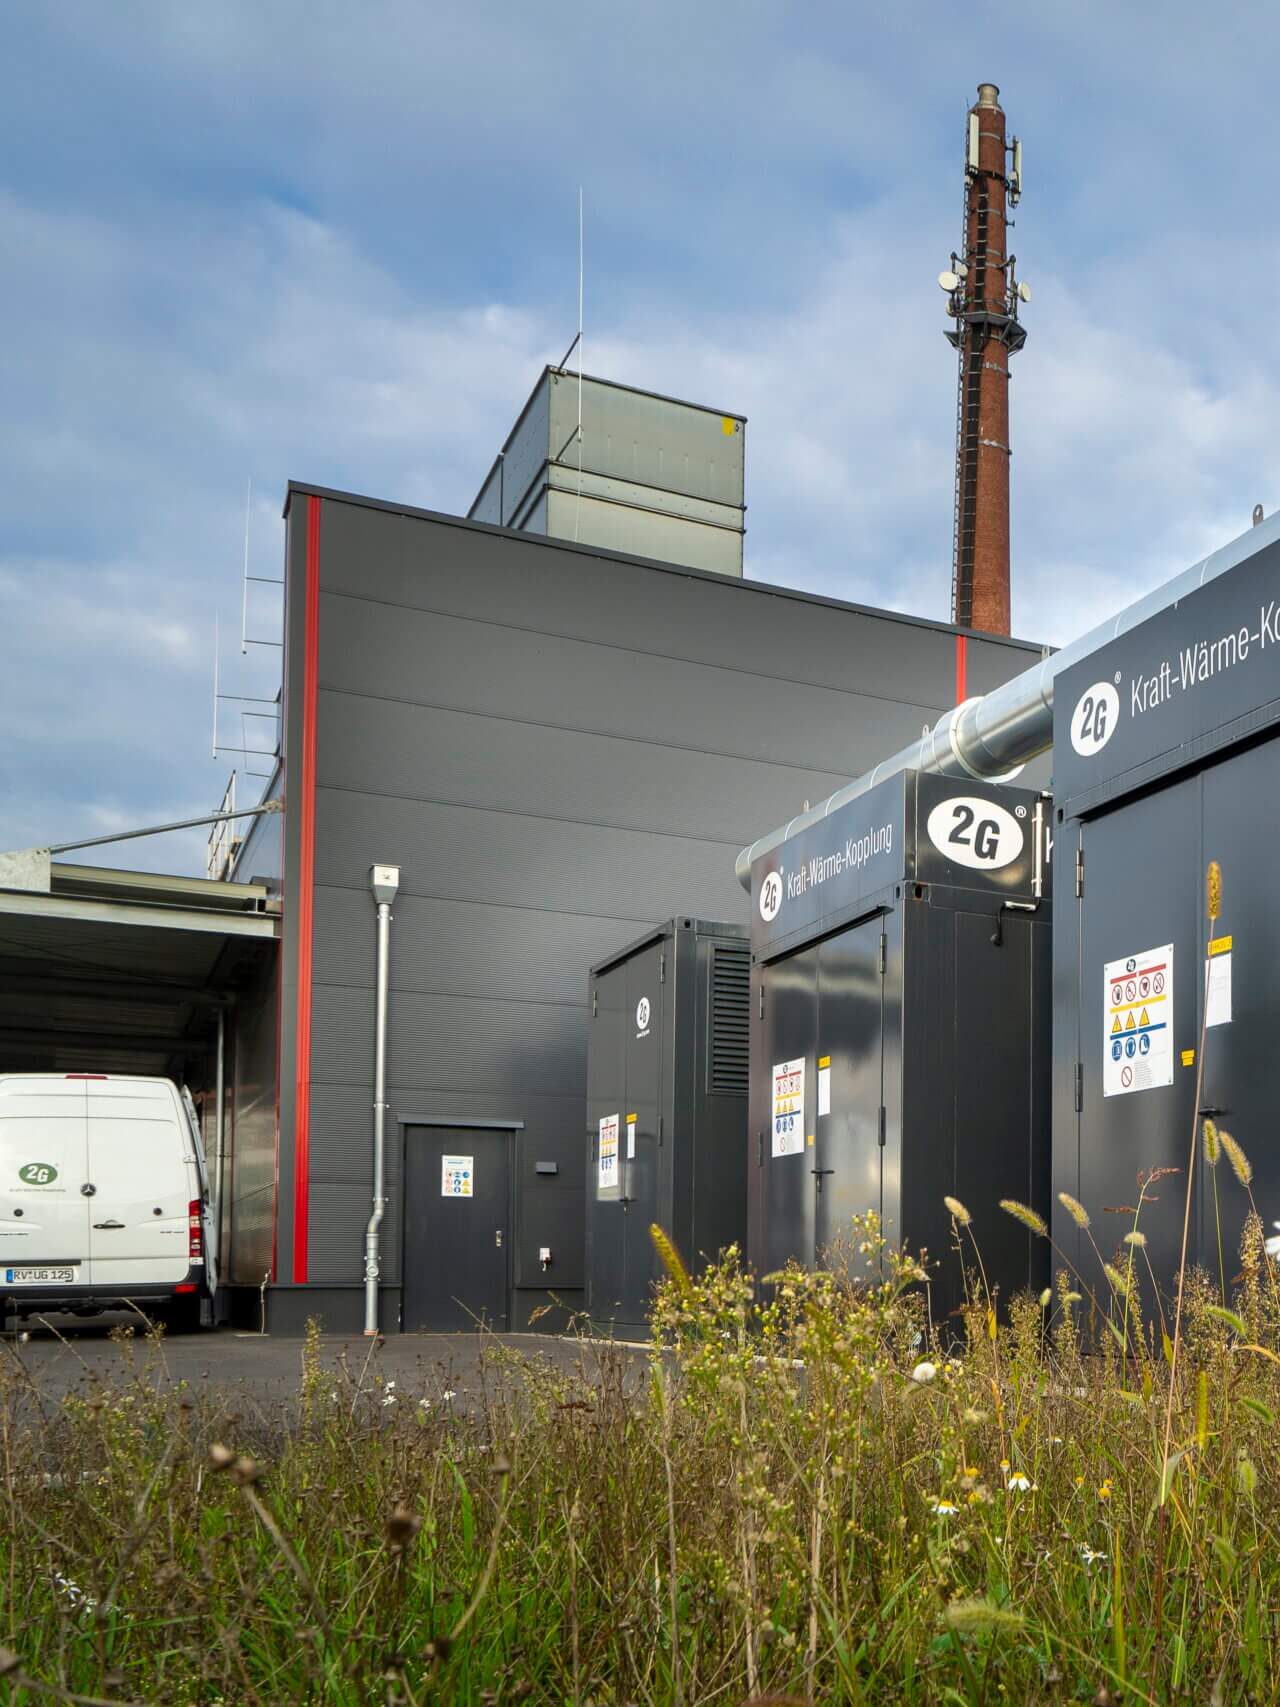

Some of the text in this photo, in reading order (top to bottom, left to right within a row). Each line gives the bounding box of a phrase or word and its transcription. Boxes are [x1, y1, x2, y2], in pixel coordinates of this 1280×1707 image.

[1080, 696, 1108, 743] 2G
[948, 805, 1001, 861] 2G
[764, 823, 893, 913] 2G Kraft-Wärme-Kopplung
[27, 1165, 49, 1182] 2G
[51, 1270, 72, 1280] 125
